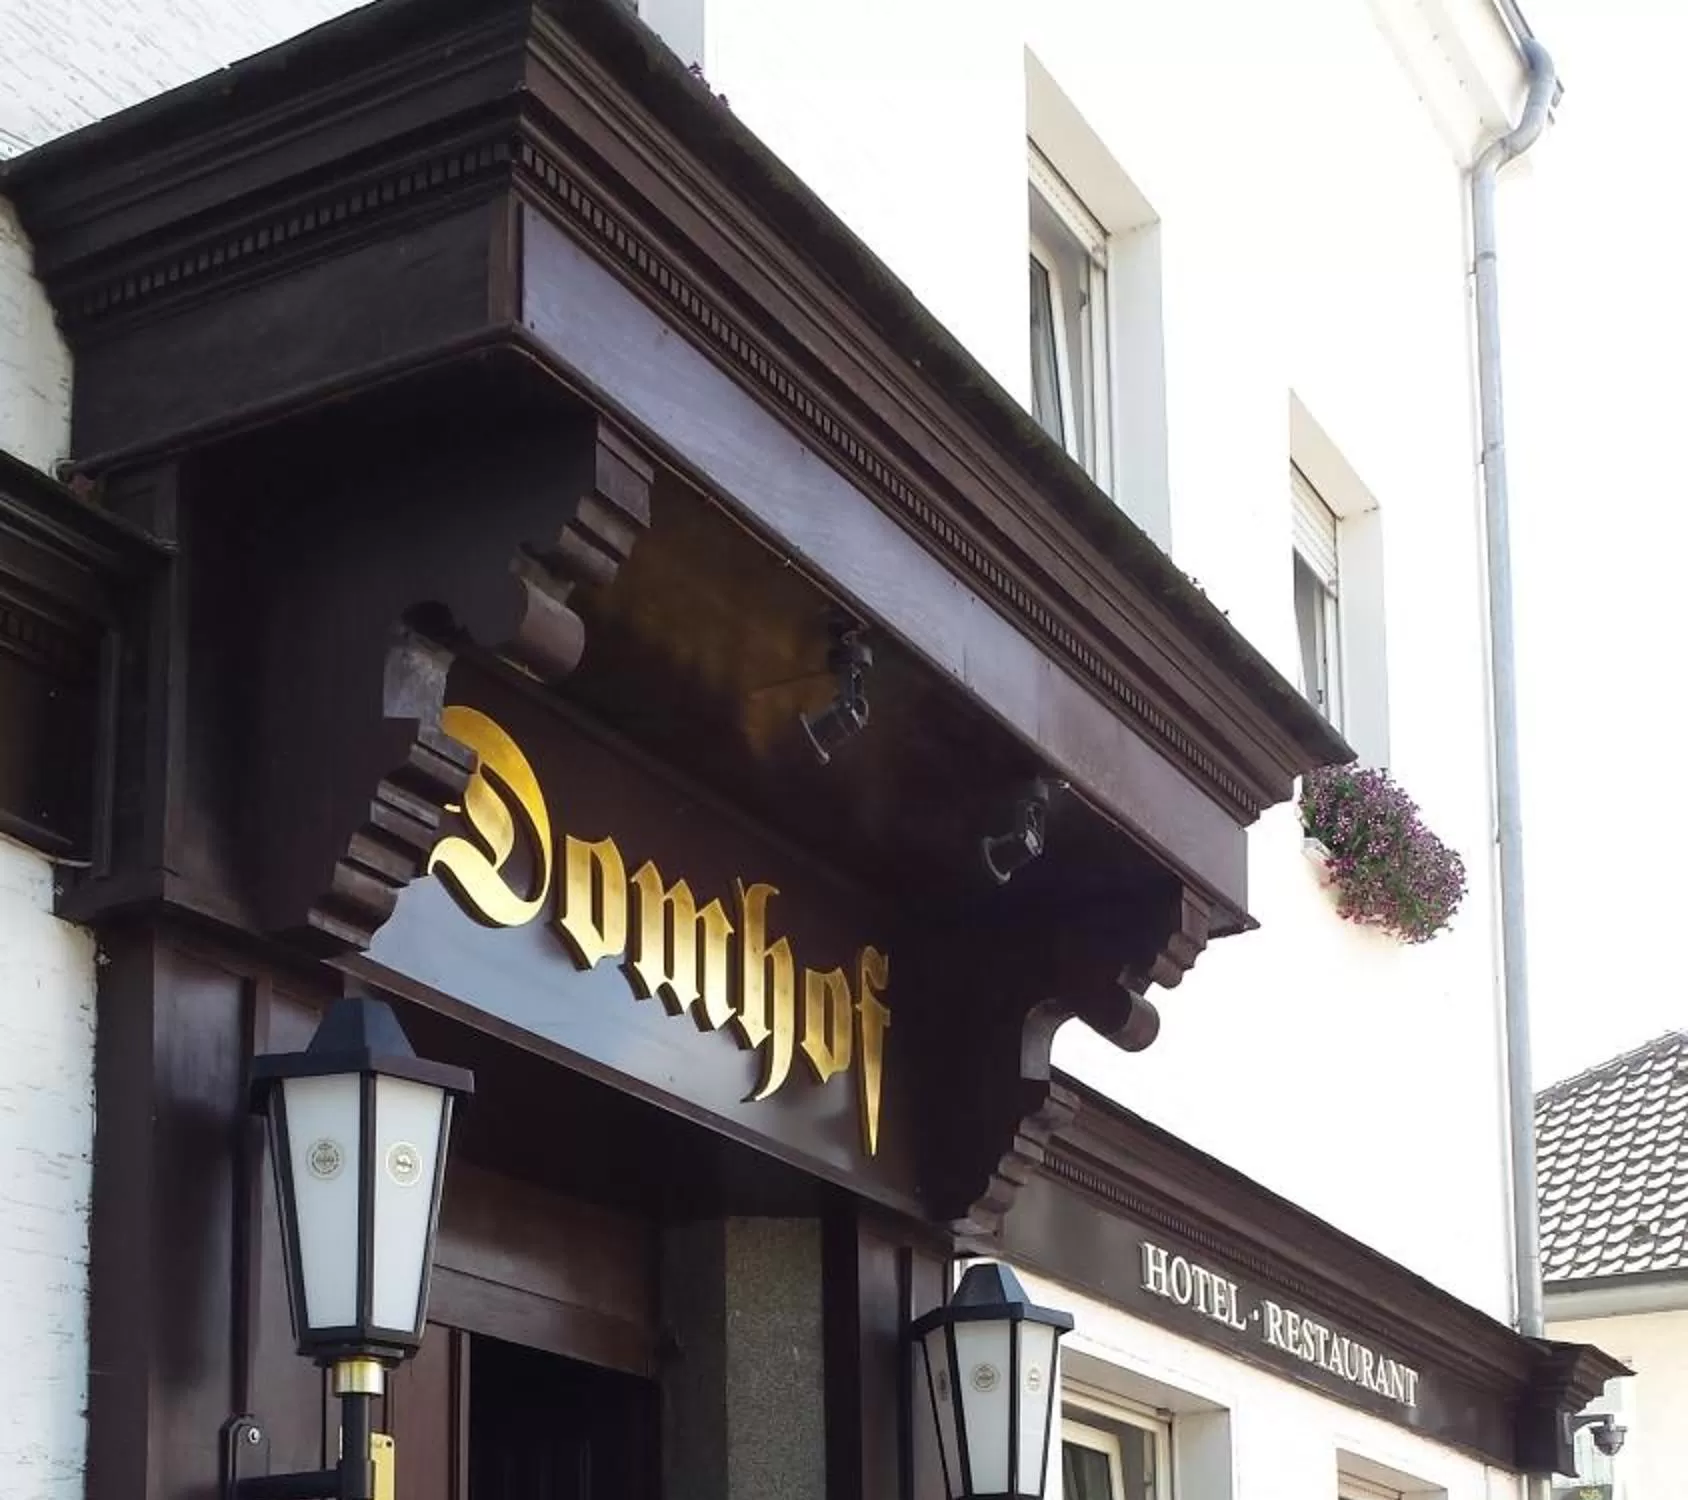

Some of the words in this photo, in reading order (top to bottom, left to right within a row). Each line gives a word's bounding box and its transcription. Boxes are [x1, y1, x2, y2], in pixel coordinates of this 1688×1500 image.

[428, 705, 891, 1157] Domhof
[1142, 1242, 1247, 1331] HOTEL
[1264, 1300, 1419, 1407] RESTAURANT
